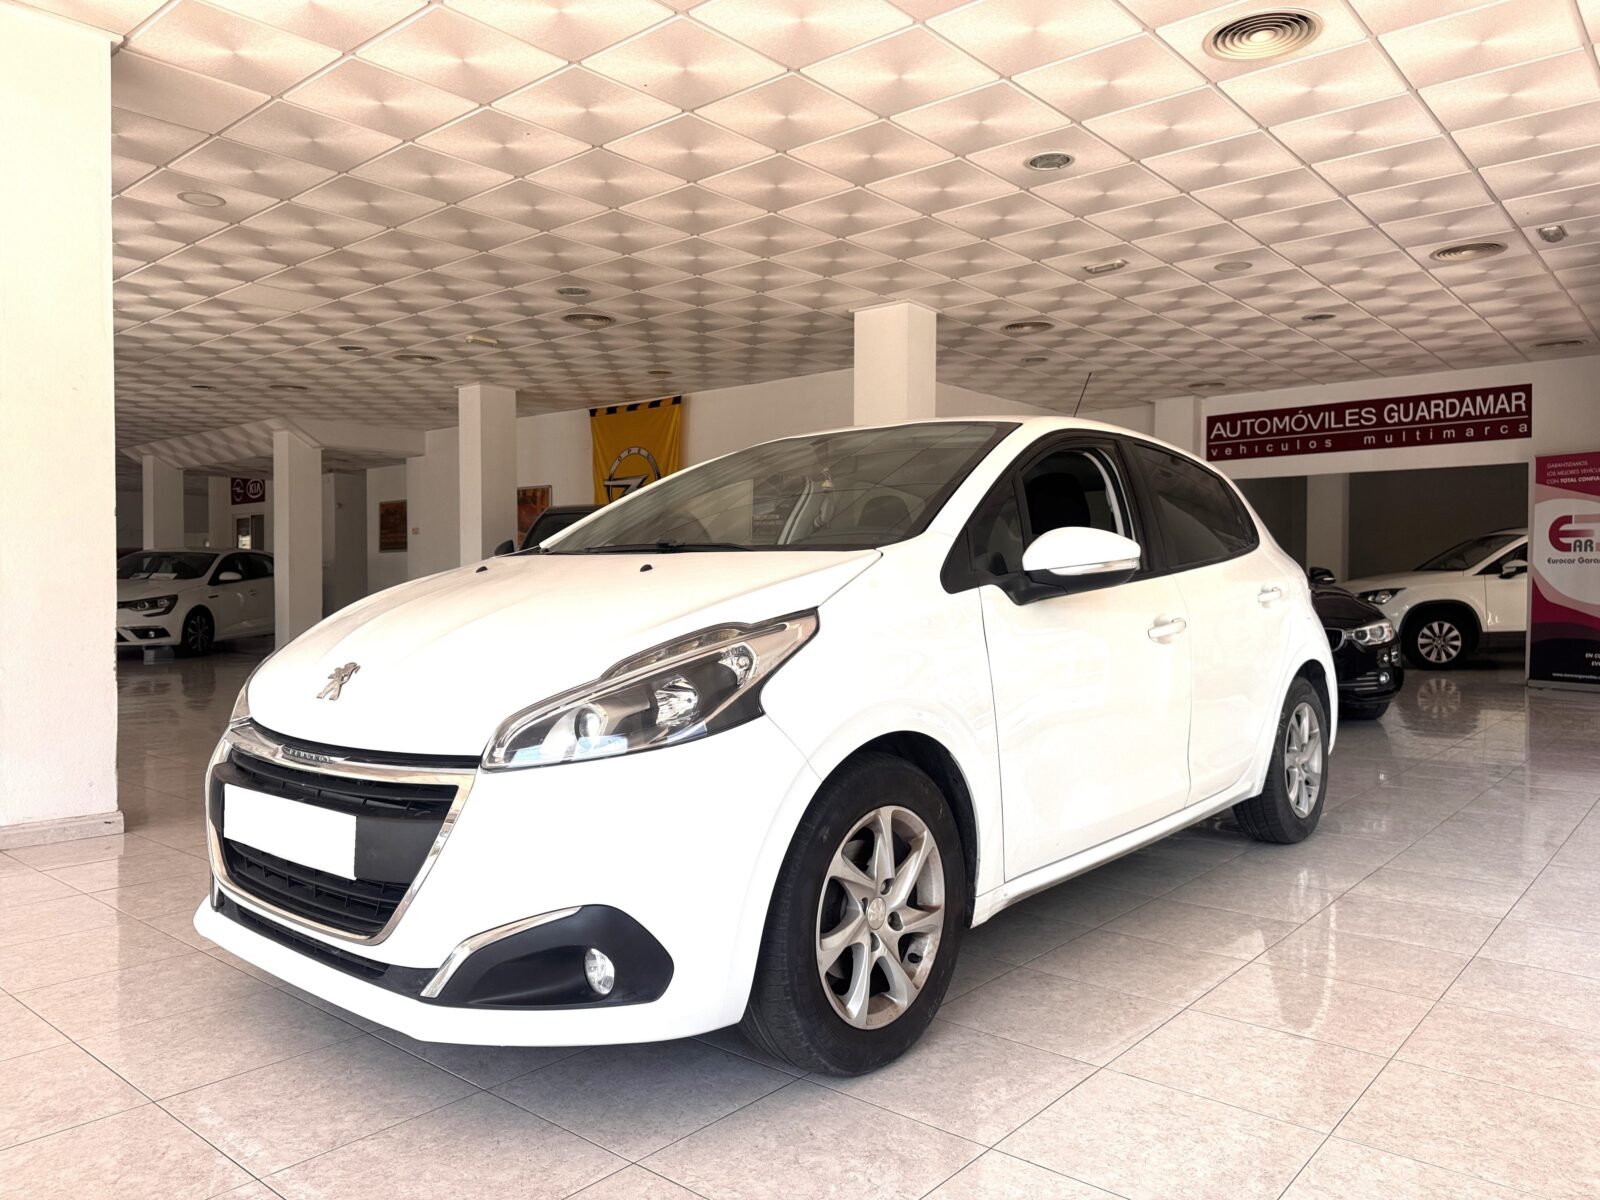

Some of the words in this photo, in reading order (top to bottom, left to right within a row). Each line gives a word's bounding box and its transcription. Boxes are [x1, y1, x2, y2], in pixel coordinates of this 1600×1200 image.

[1210, 407, 1378, 439] AUTOMÓVILES
[1384, 392, 1527, 424] GUARDAMAR
[1363, 423, 1528, 445] multimarca
[617, 447, 651, 462] OPEL
[249, 481, 262, 495] KIA
[1547, 557, 1576, 565] Eurocar
